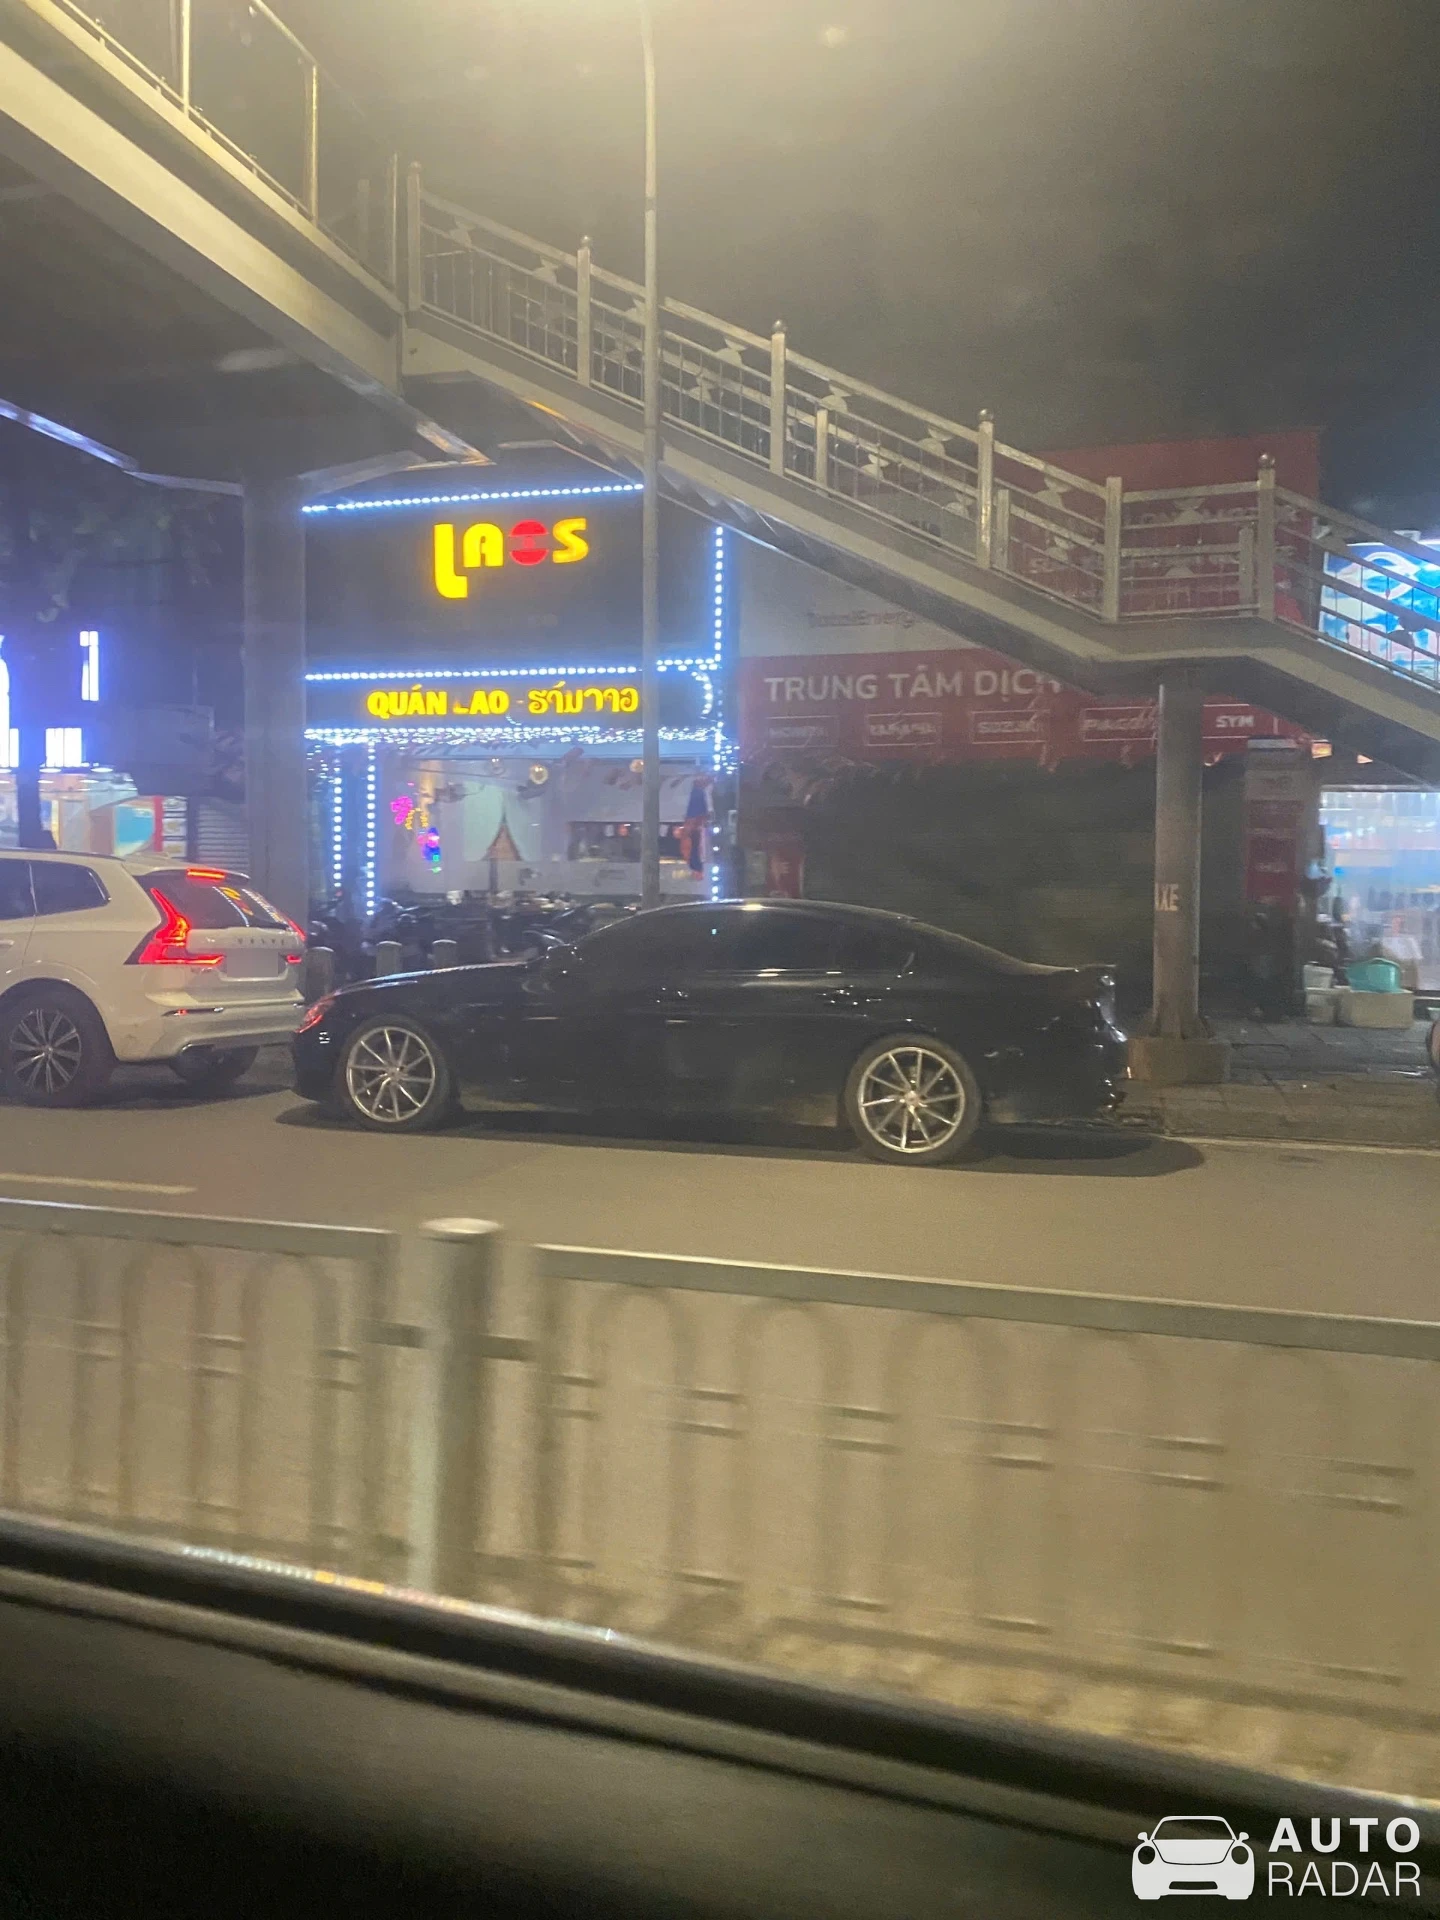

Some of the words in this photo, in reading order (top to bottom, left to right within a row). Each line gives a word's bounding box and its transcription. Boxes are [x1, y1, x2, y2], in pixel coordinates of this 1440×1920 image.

[434, 518, 589, 599] LAOS
[366, 684, 447, 719] QUÁN
[764, 674, 878, 702] TRUNG
[1215, 715, 1254, 728] SYM
